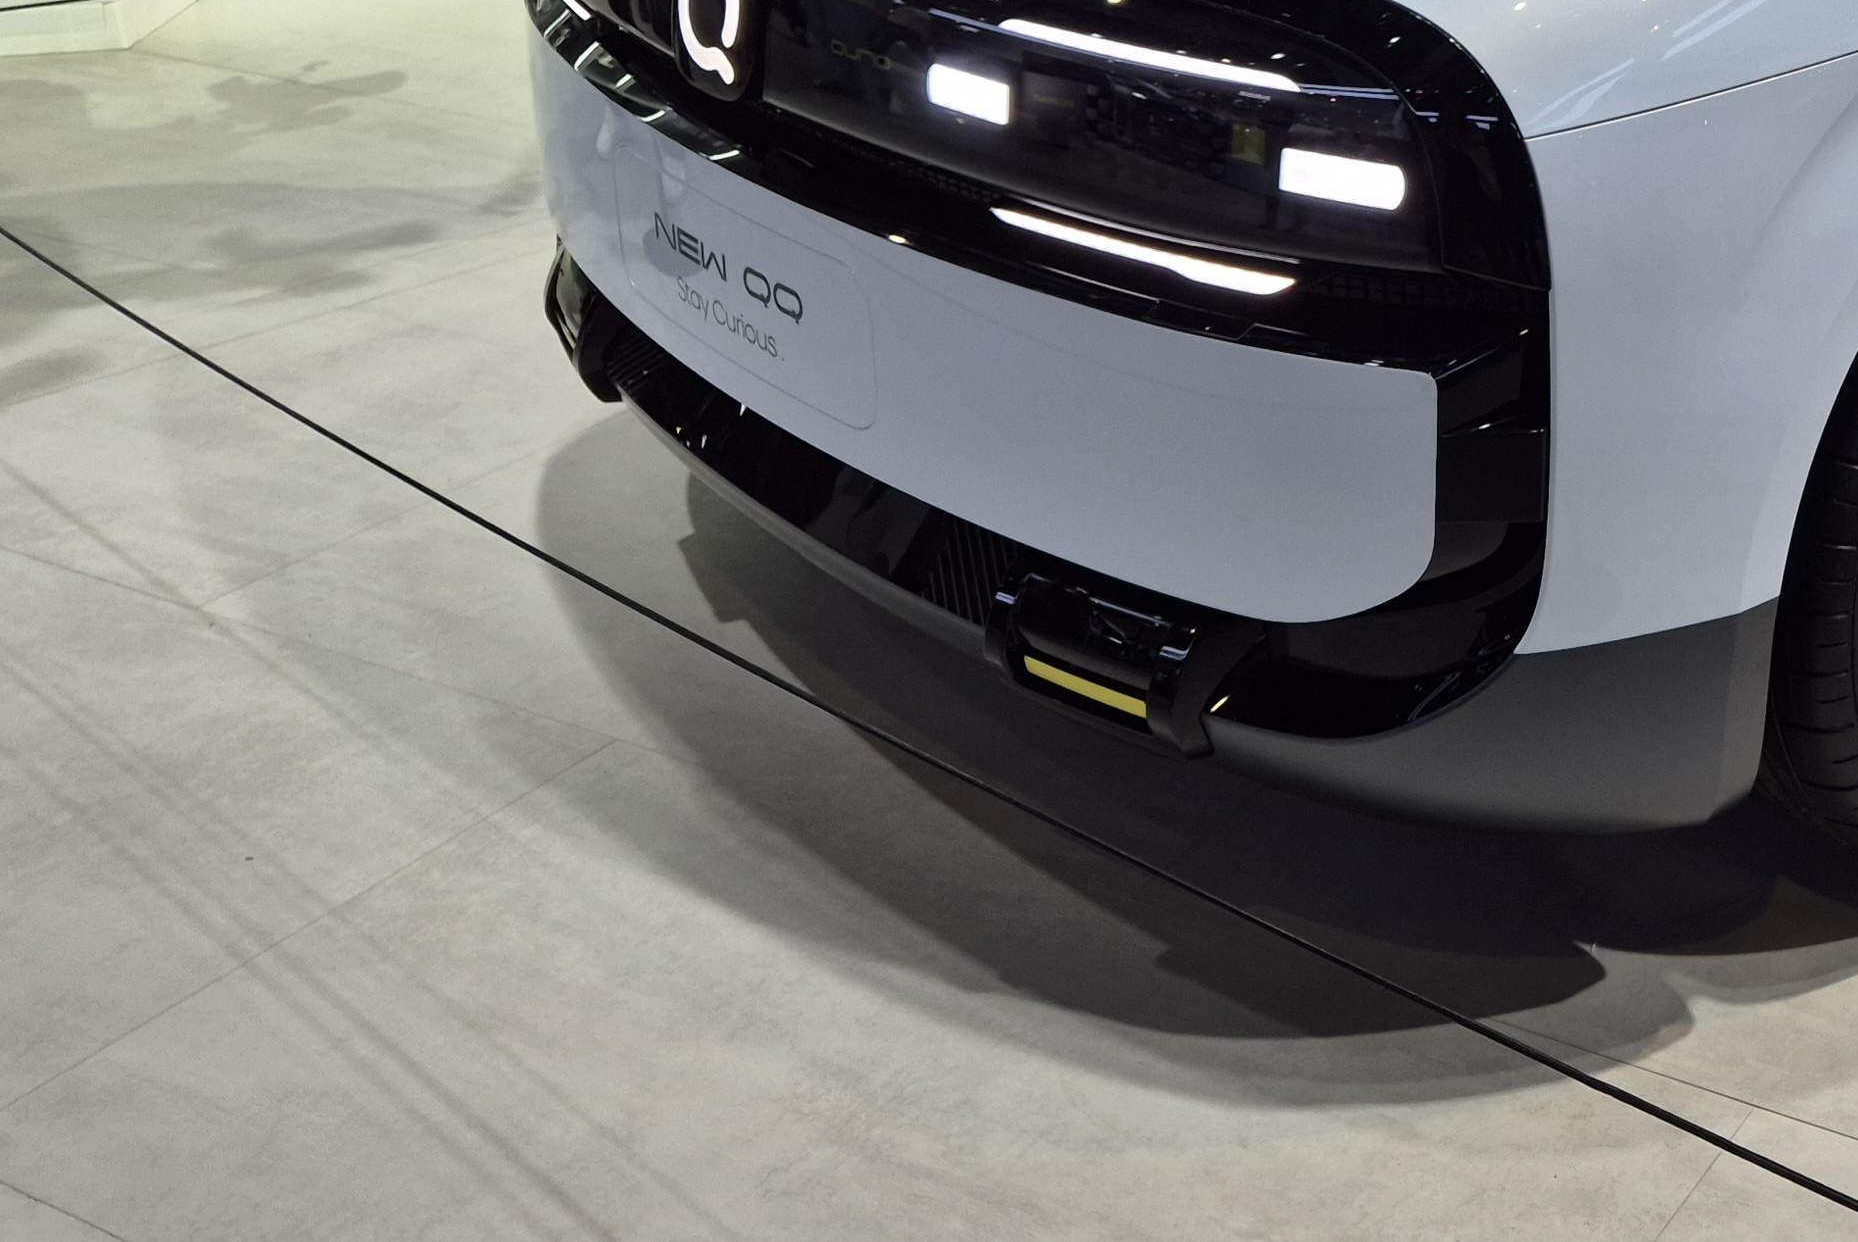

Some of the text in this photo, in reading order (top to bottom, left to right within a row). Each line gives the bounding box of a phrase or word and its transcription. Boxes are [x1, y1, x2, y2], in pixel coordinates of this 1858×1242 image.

[654, 212, 804, 326] NEW QQ
[677, 276, 710, 323] Stay
